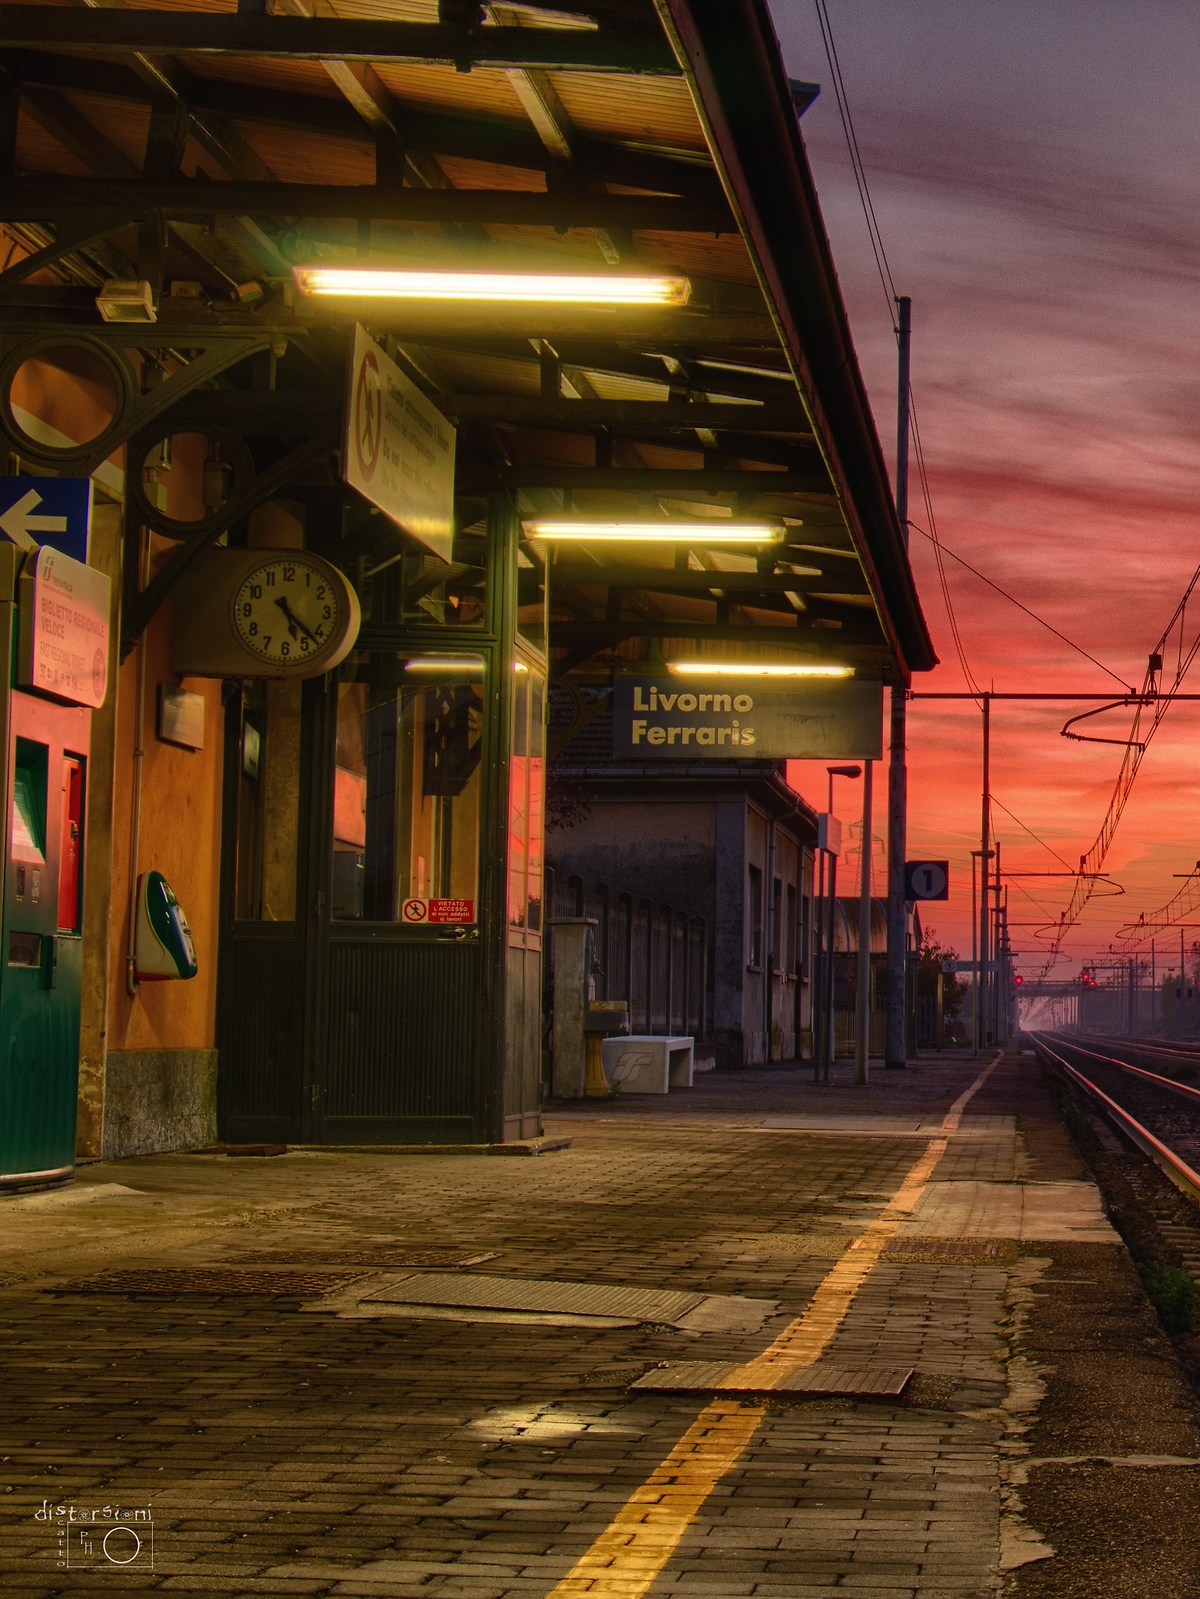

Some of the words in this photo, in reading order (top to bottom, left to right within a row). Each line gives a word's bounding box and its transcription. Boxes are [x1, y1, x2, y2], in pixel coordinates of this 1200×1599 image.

[266, 572, 276, 586] 11
[283, 567, 295, 582] 12
[306, 573, 311, 587] 1
[250, 585, 262, 599] 10
[317, 585, 326, 600] 2
[243, 603, 252, 617] 9
[322, 606, 331, 620] 3
[42, 597, 73, 624] BIGLIETTO
[74, 612, 105, 638] REGIONALE
[41, 616, 64, 640] VELOCE
[249, 622, 257, 636] 8
[315, 624, 324, 638] 4
[263, 636, 272, 650] 7
[281, 642, 290, 656] 6
[301, 637, 309, 652] 5
[633, 686, 754, 712] Livorno
[632, 720, 756, 746] Ferraris
[922, 869, 932, 892] 1
